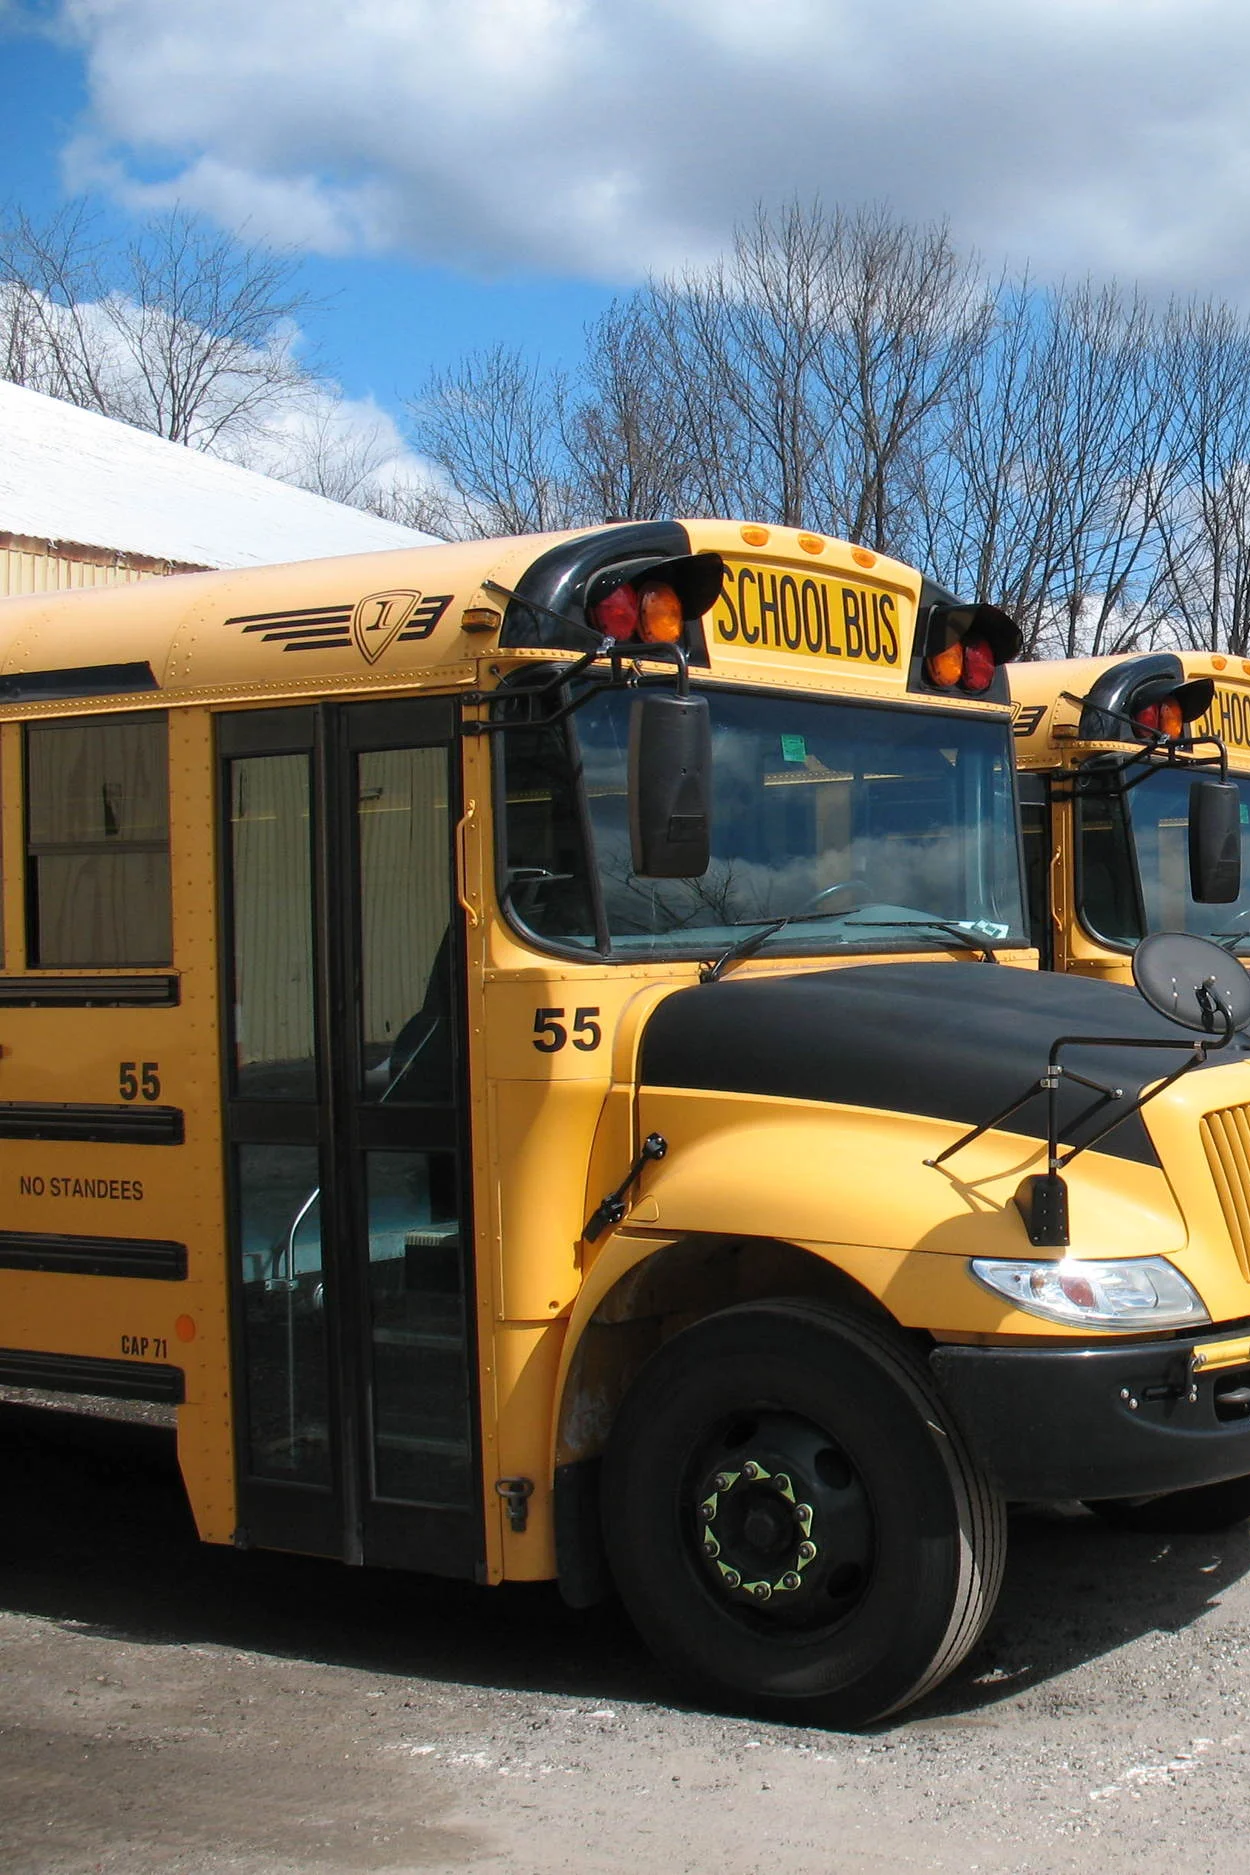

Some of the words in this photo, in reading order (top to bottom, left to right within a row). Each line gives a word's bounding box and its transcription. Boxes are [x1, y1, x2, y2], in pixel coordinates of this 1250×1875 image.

[718, 564, 842, 656] SCHOOL
[842, 588, 898, 665] BUS
[532, 1007, 602, 1053] 55
[119, 1062, 161, 1101] 55
[20, 1175, 46, 1196] NO
[50, 1177, 144, 1200] STANDEES
[121, 1334, 149, 1356] CAP
[153, 1338, 168, 1359] 71
